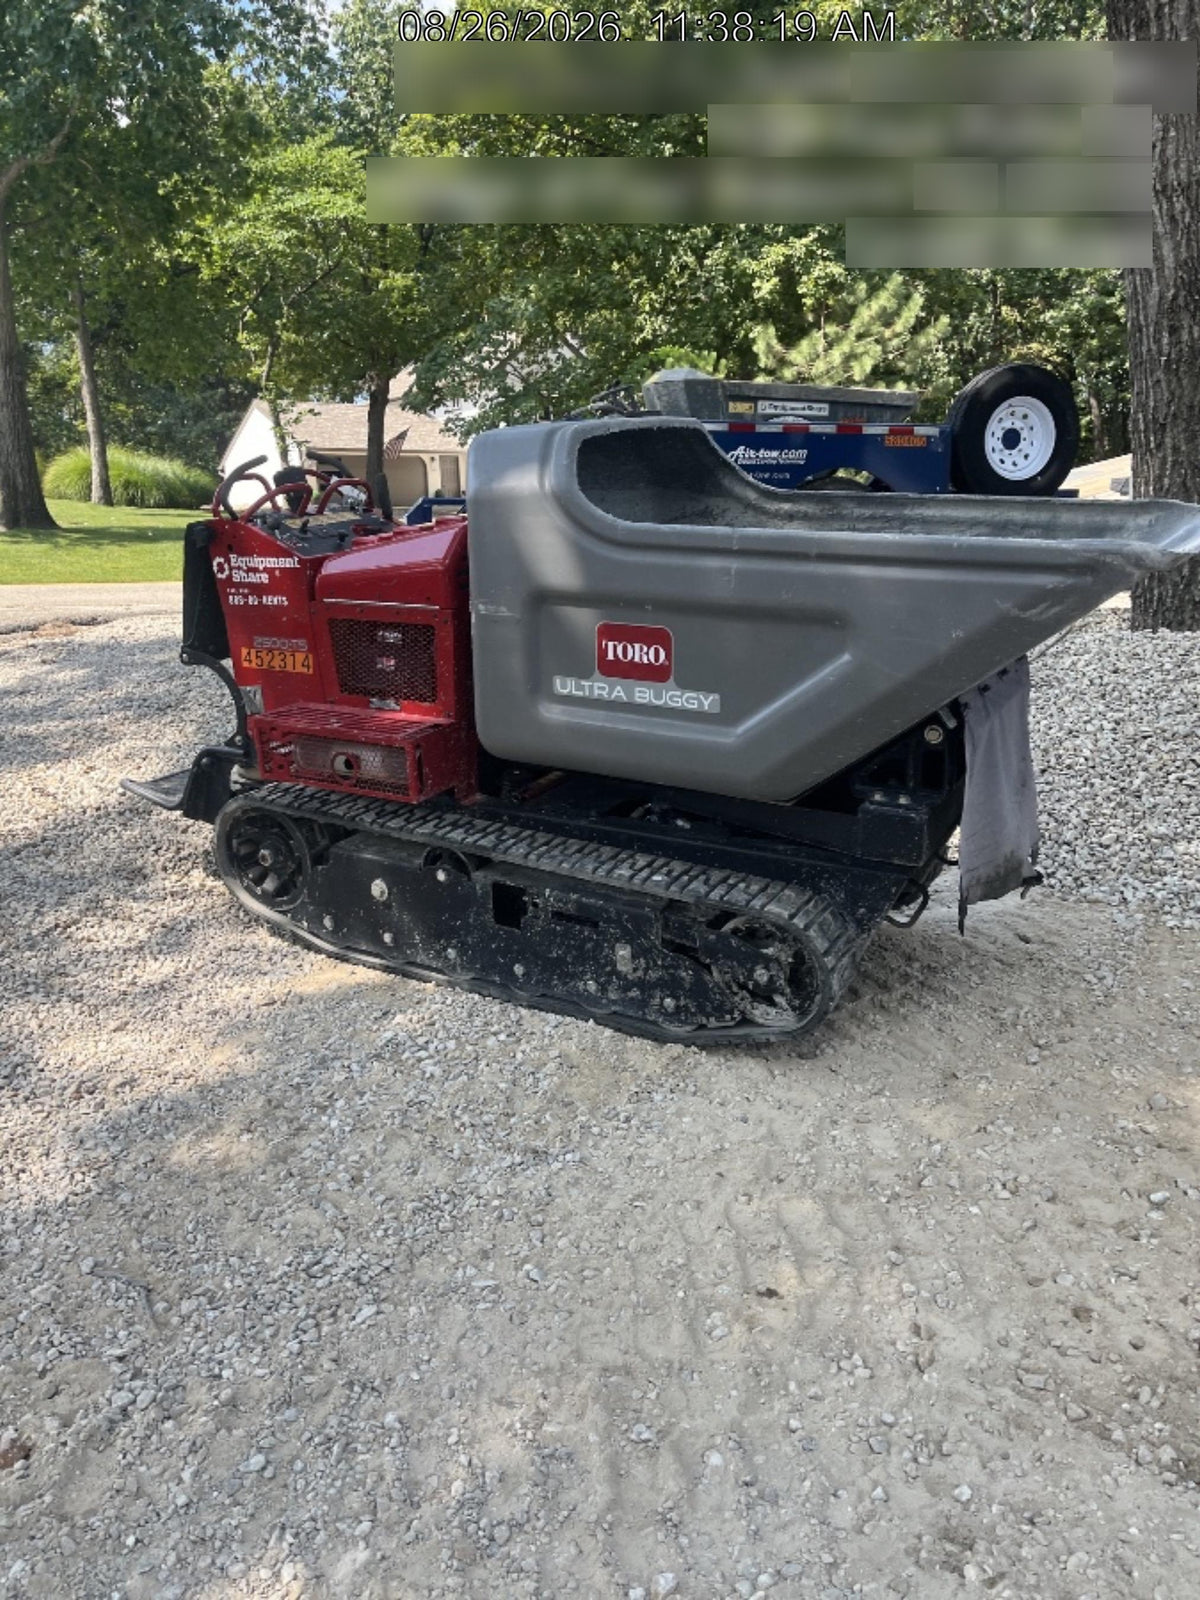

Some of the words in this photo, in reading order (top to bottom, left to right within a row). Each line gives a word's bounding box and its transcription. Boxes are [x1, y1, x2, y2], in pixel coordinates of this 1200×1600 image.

[229, 554, 301, 570] Equipment
[232, 569, 269, 584] Share
[243, 649, 311, 672] 452314
[602, 640, 666, 666] TORO
[555, 679, 627, 702] ULTRA
[634, 687, 714, 710] BUGGY
